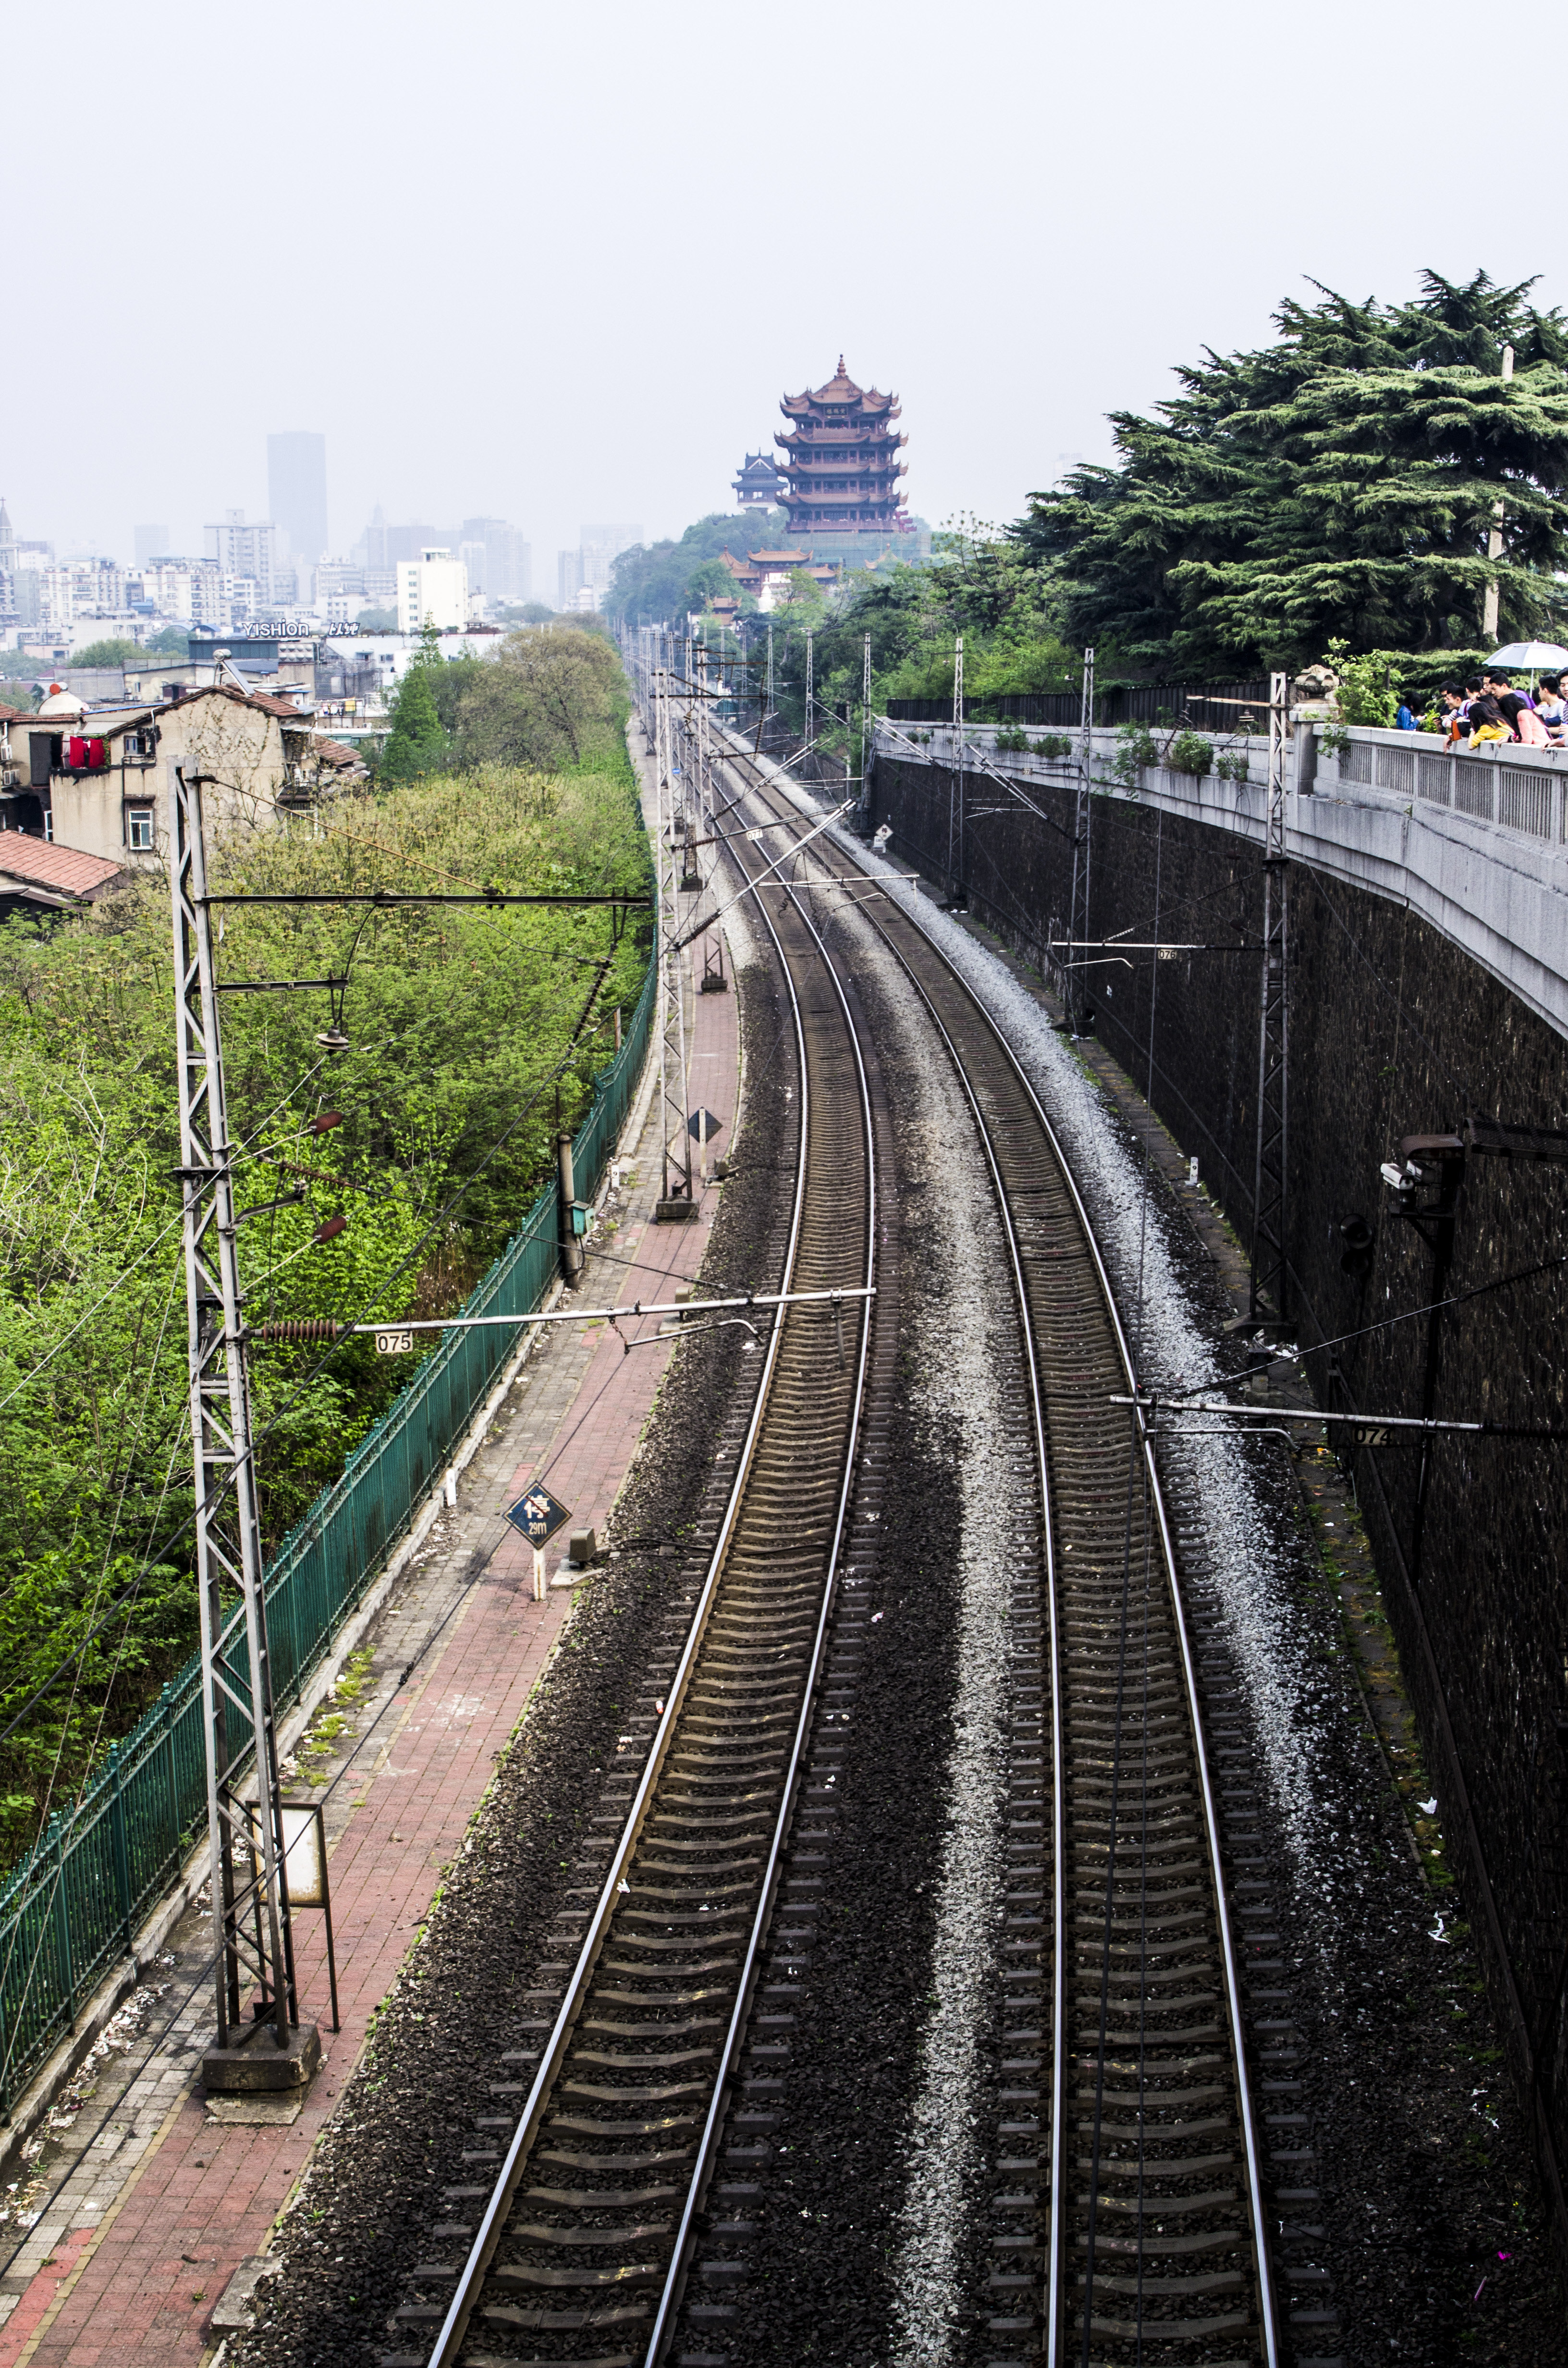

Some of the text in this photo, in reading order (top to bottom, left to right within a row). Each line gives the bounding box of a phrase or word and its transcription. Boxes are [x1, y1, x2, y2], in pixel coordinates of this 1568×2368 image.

[748, 829, 760, 839] 077
[1159, 950, 1176, 959] 076
[378, 1334, 411, 1352] 075
[1355, 1428, 1392, 1446] 074
[524, 1494, 551, 1518] 停
[528, 1522, 547, 1535] 29m
